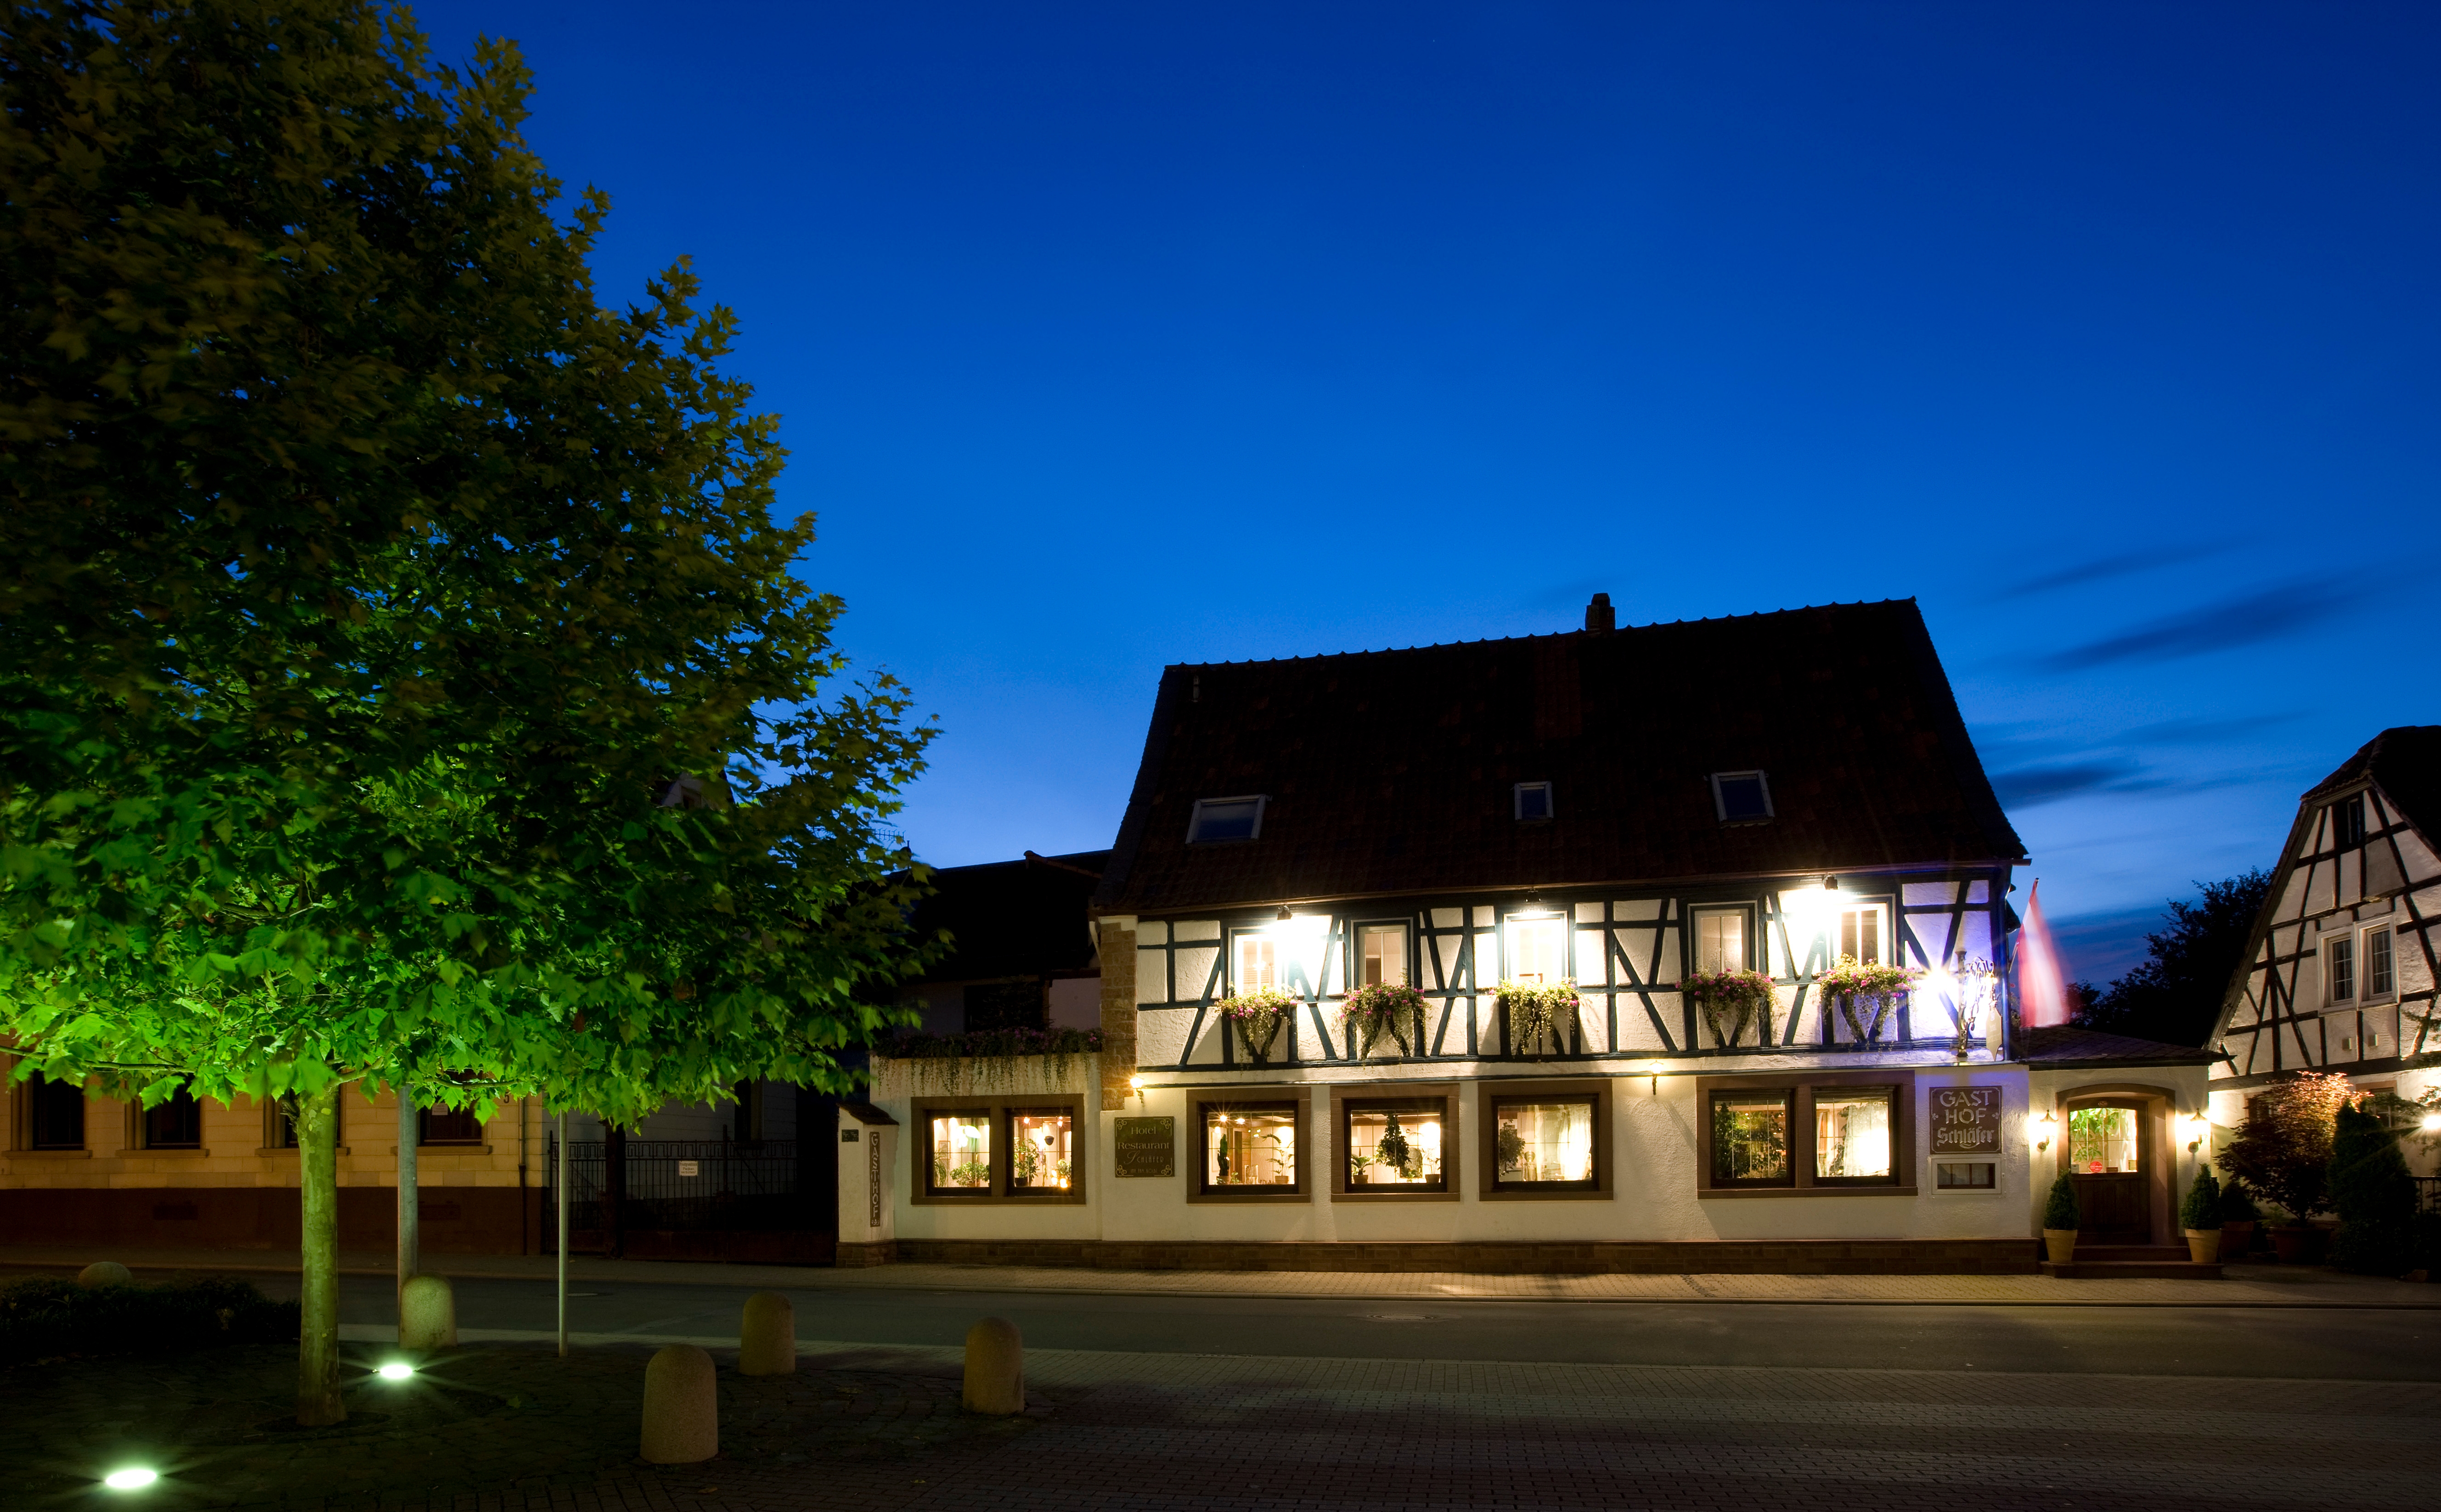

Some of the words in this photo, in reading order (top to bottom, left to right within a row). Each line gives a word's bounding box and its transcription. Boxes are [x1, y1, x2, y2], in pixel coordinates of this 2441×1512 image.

[1939, 1090, 1992, 1107] GAST
[1945, 1107, 1987, 1124] HOF
[1131, 1126, 1156, 1135] Hotel
[1937, 1126, 1995, 1149] Schläfer
